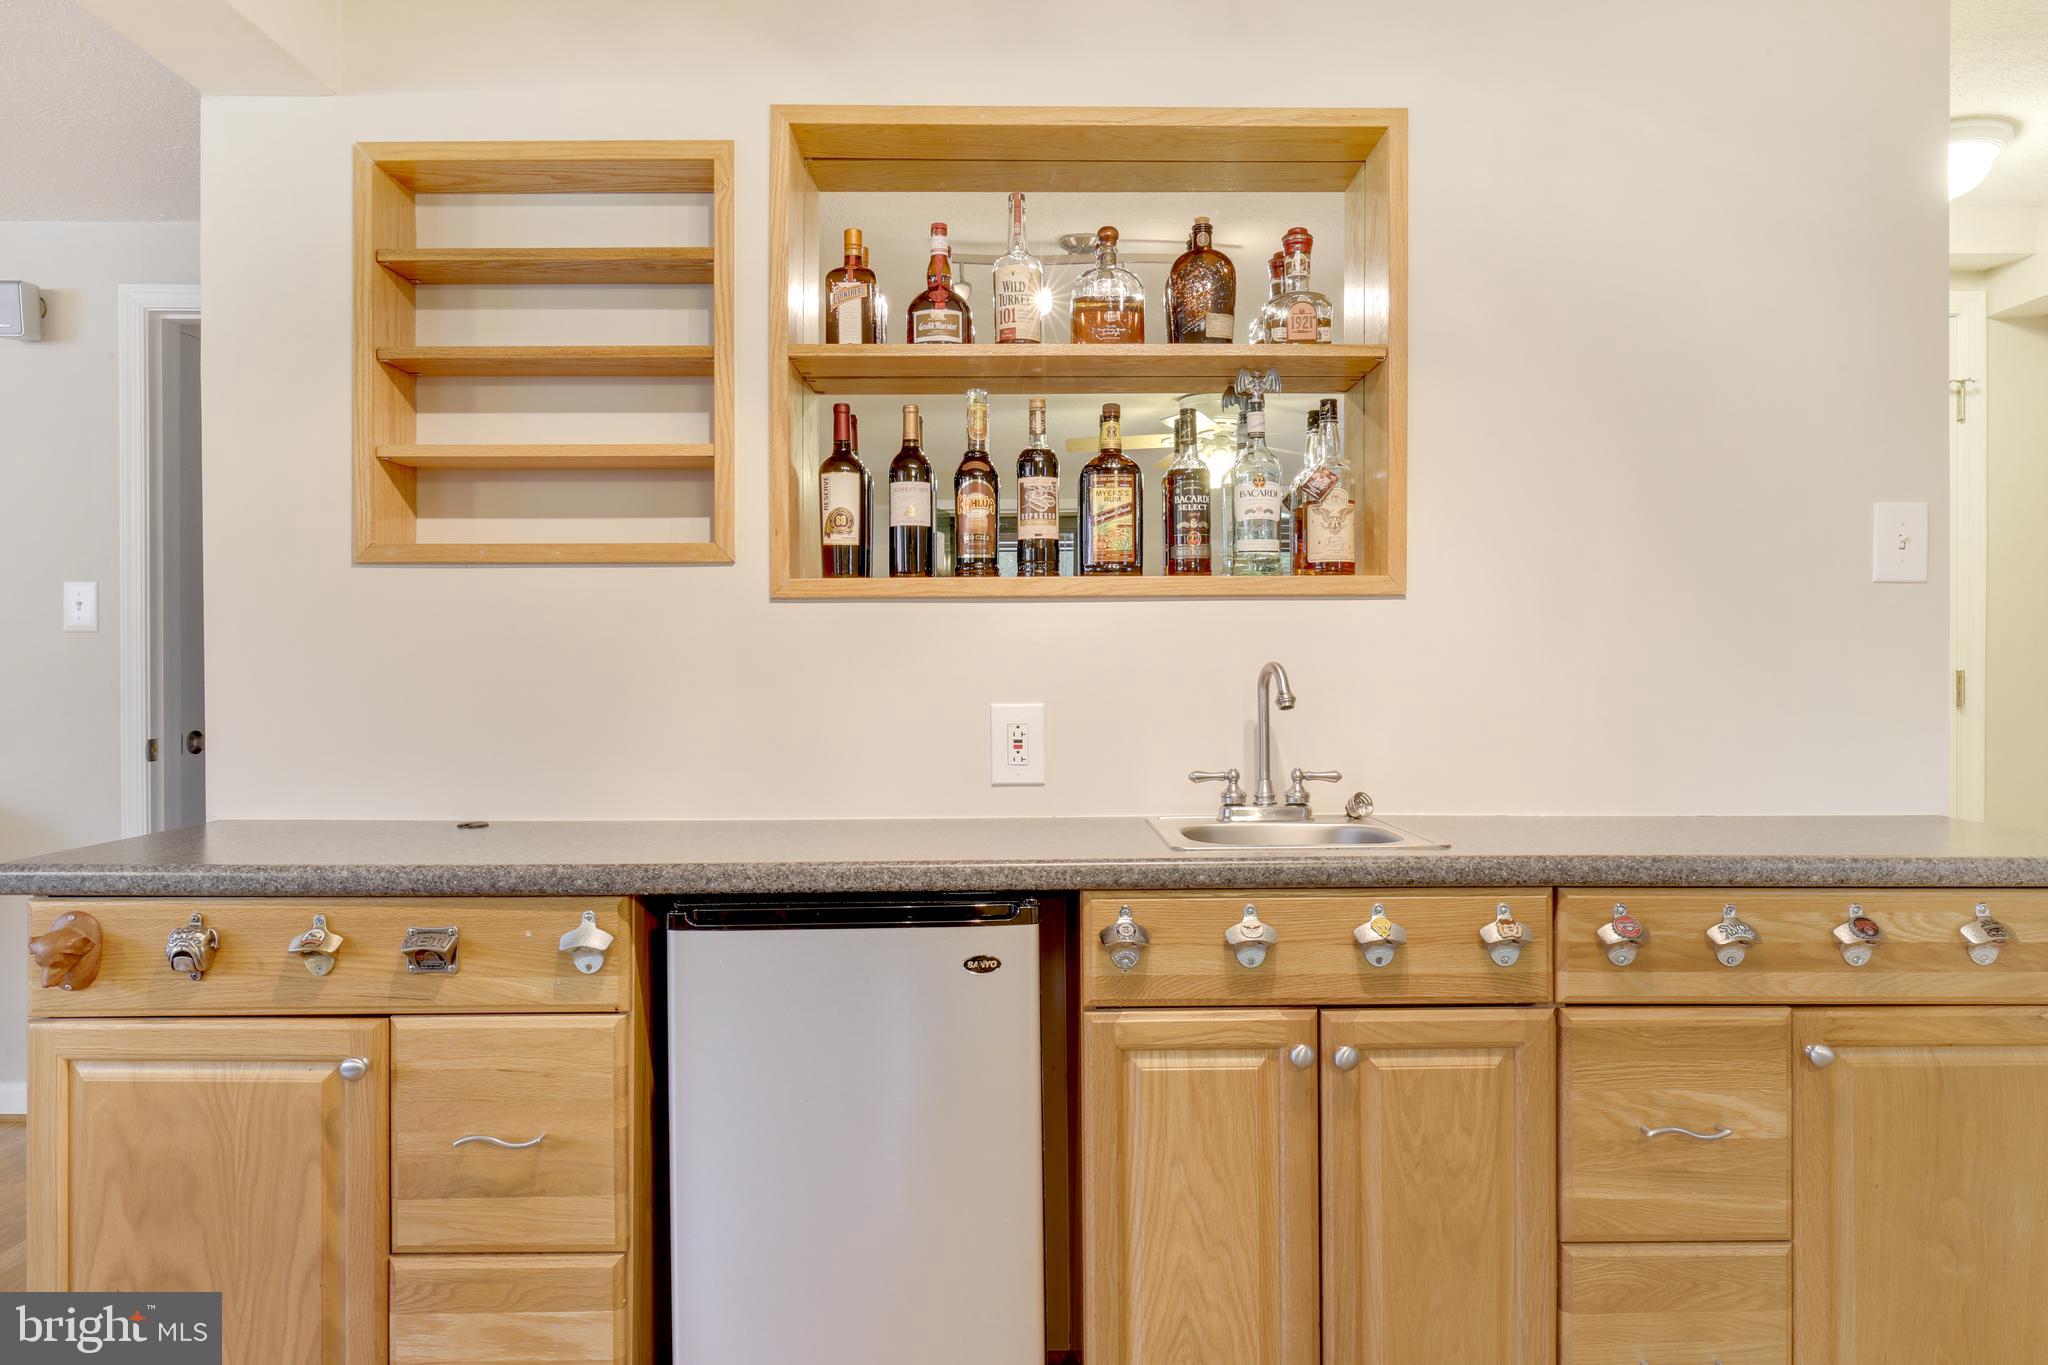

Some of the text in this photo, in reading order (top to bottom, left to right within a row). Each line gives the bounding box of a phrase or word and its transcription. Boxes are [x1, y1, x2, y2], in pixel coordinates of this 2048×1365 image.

[1002, 280, 1026, 293] WILD
[998, 293, 1031, 307] TURKEY
[999, 307, 1017, 325] 101
[1290, 315, 1313, 330] 1921
[1174, 494, 1210, 504] BACARDI
[1239, 489, 1278, 499] BACARDI
[1177, 503, 1208, 511] SELECT
[835, 515, 846, 526] 80
[405, 935, 450, 949] YETI
[967, 960, 998, 969] SANYO
